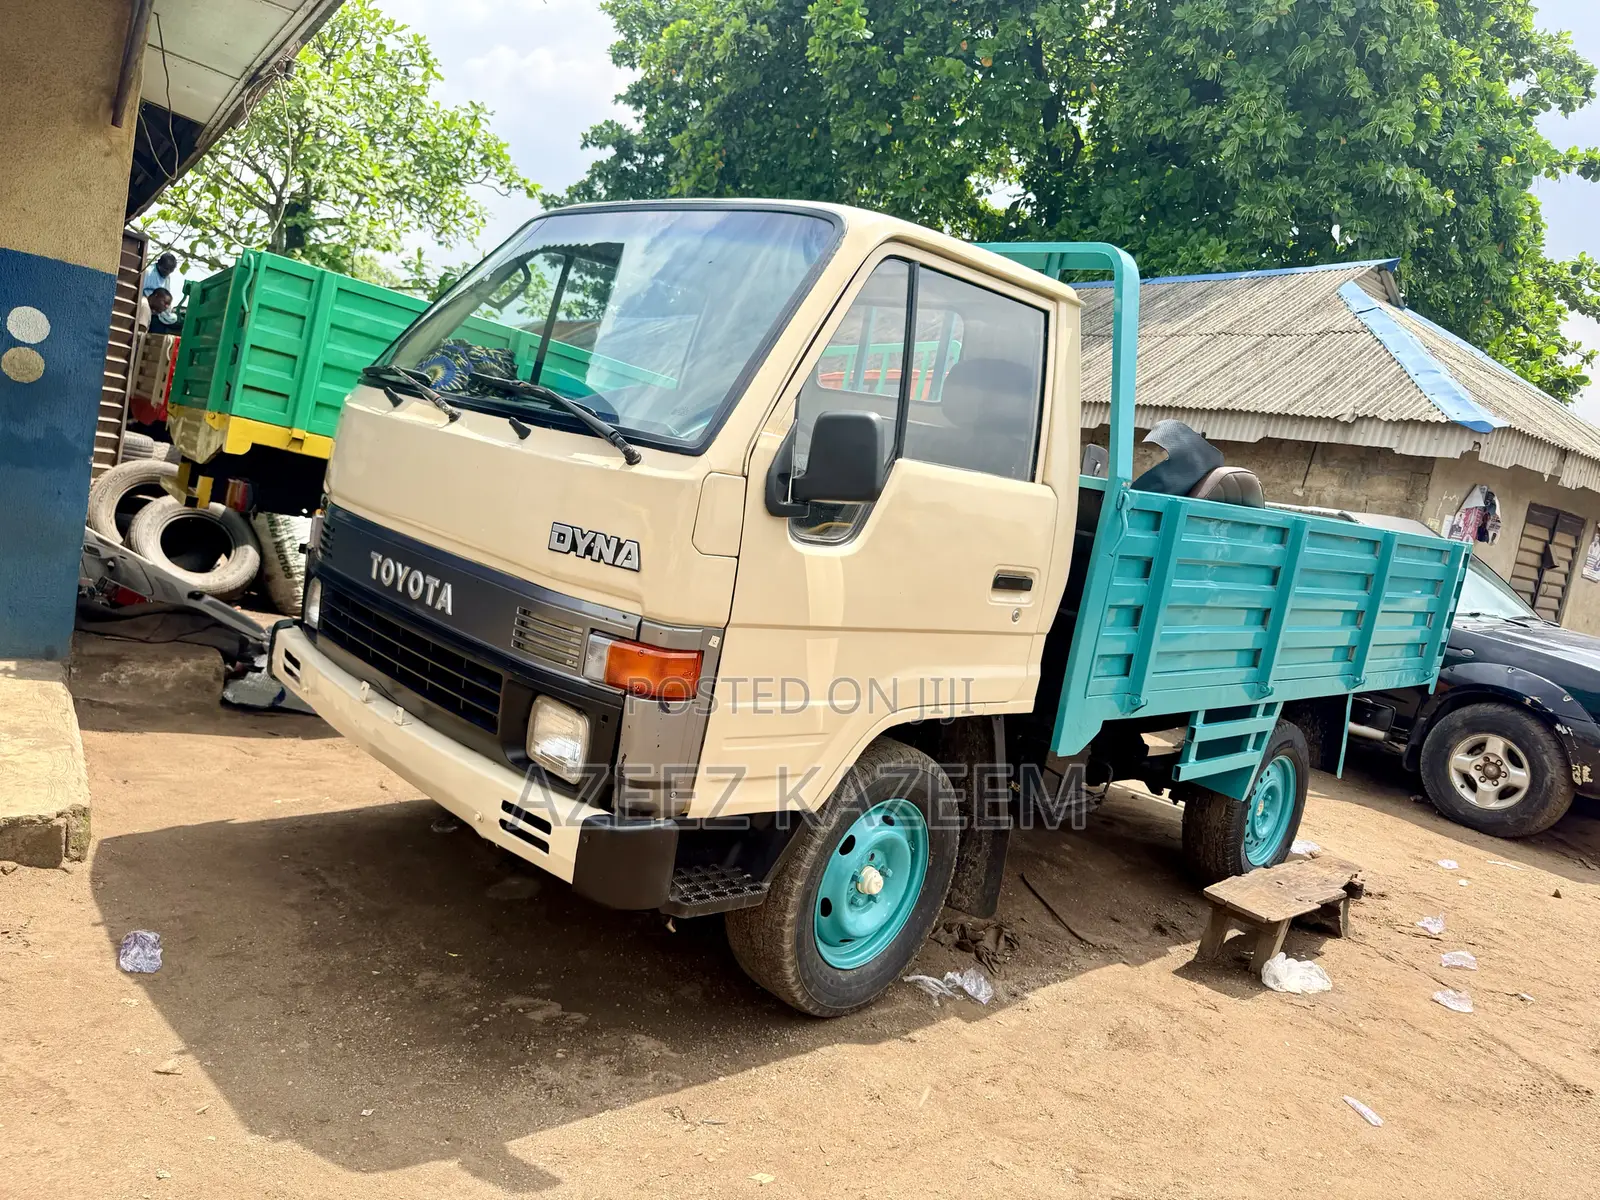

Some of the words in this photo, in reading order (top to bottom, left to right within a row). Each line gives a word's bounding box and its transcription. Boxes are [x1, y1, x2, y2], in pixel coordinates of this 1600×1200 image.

[273, 539, 293, 580] GOLDEN
[548, 522, 640, 572] DYNA
[370, 550, 452, 616] TOYOTA
